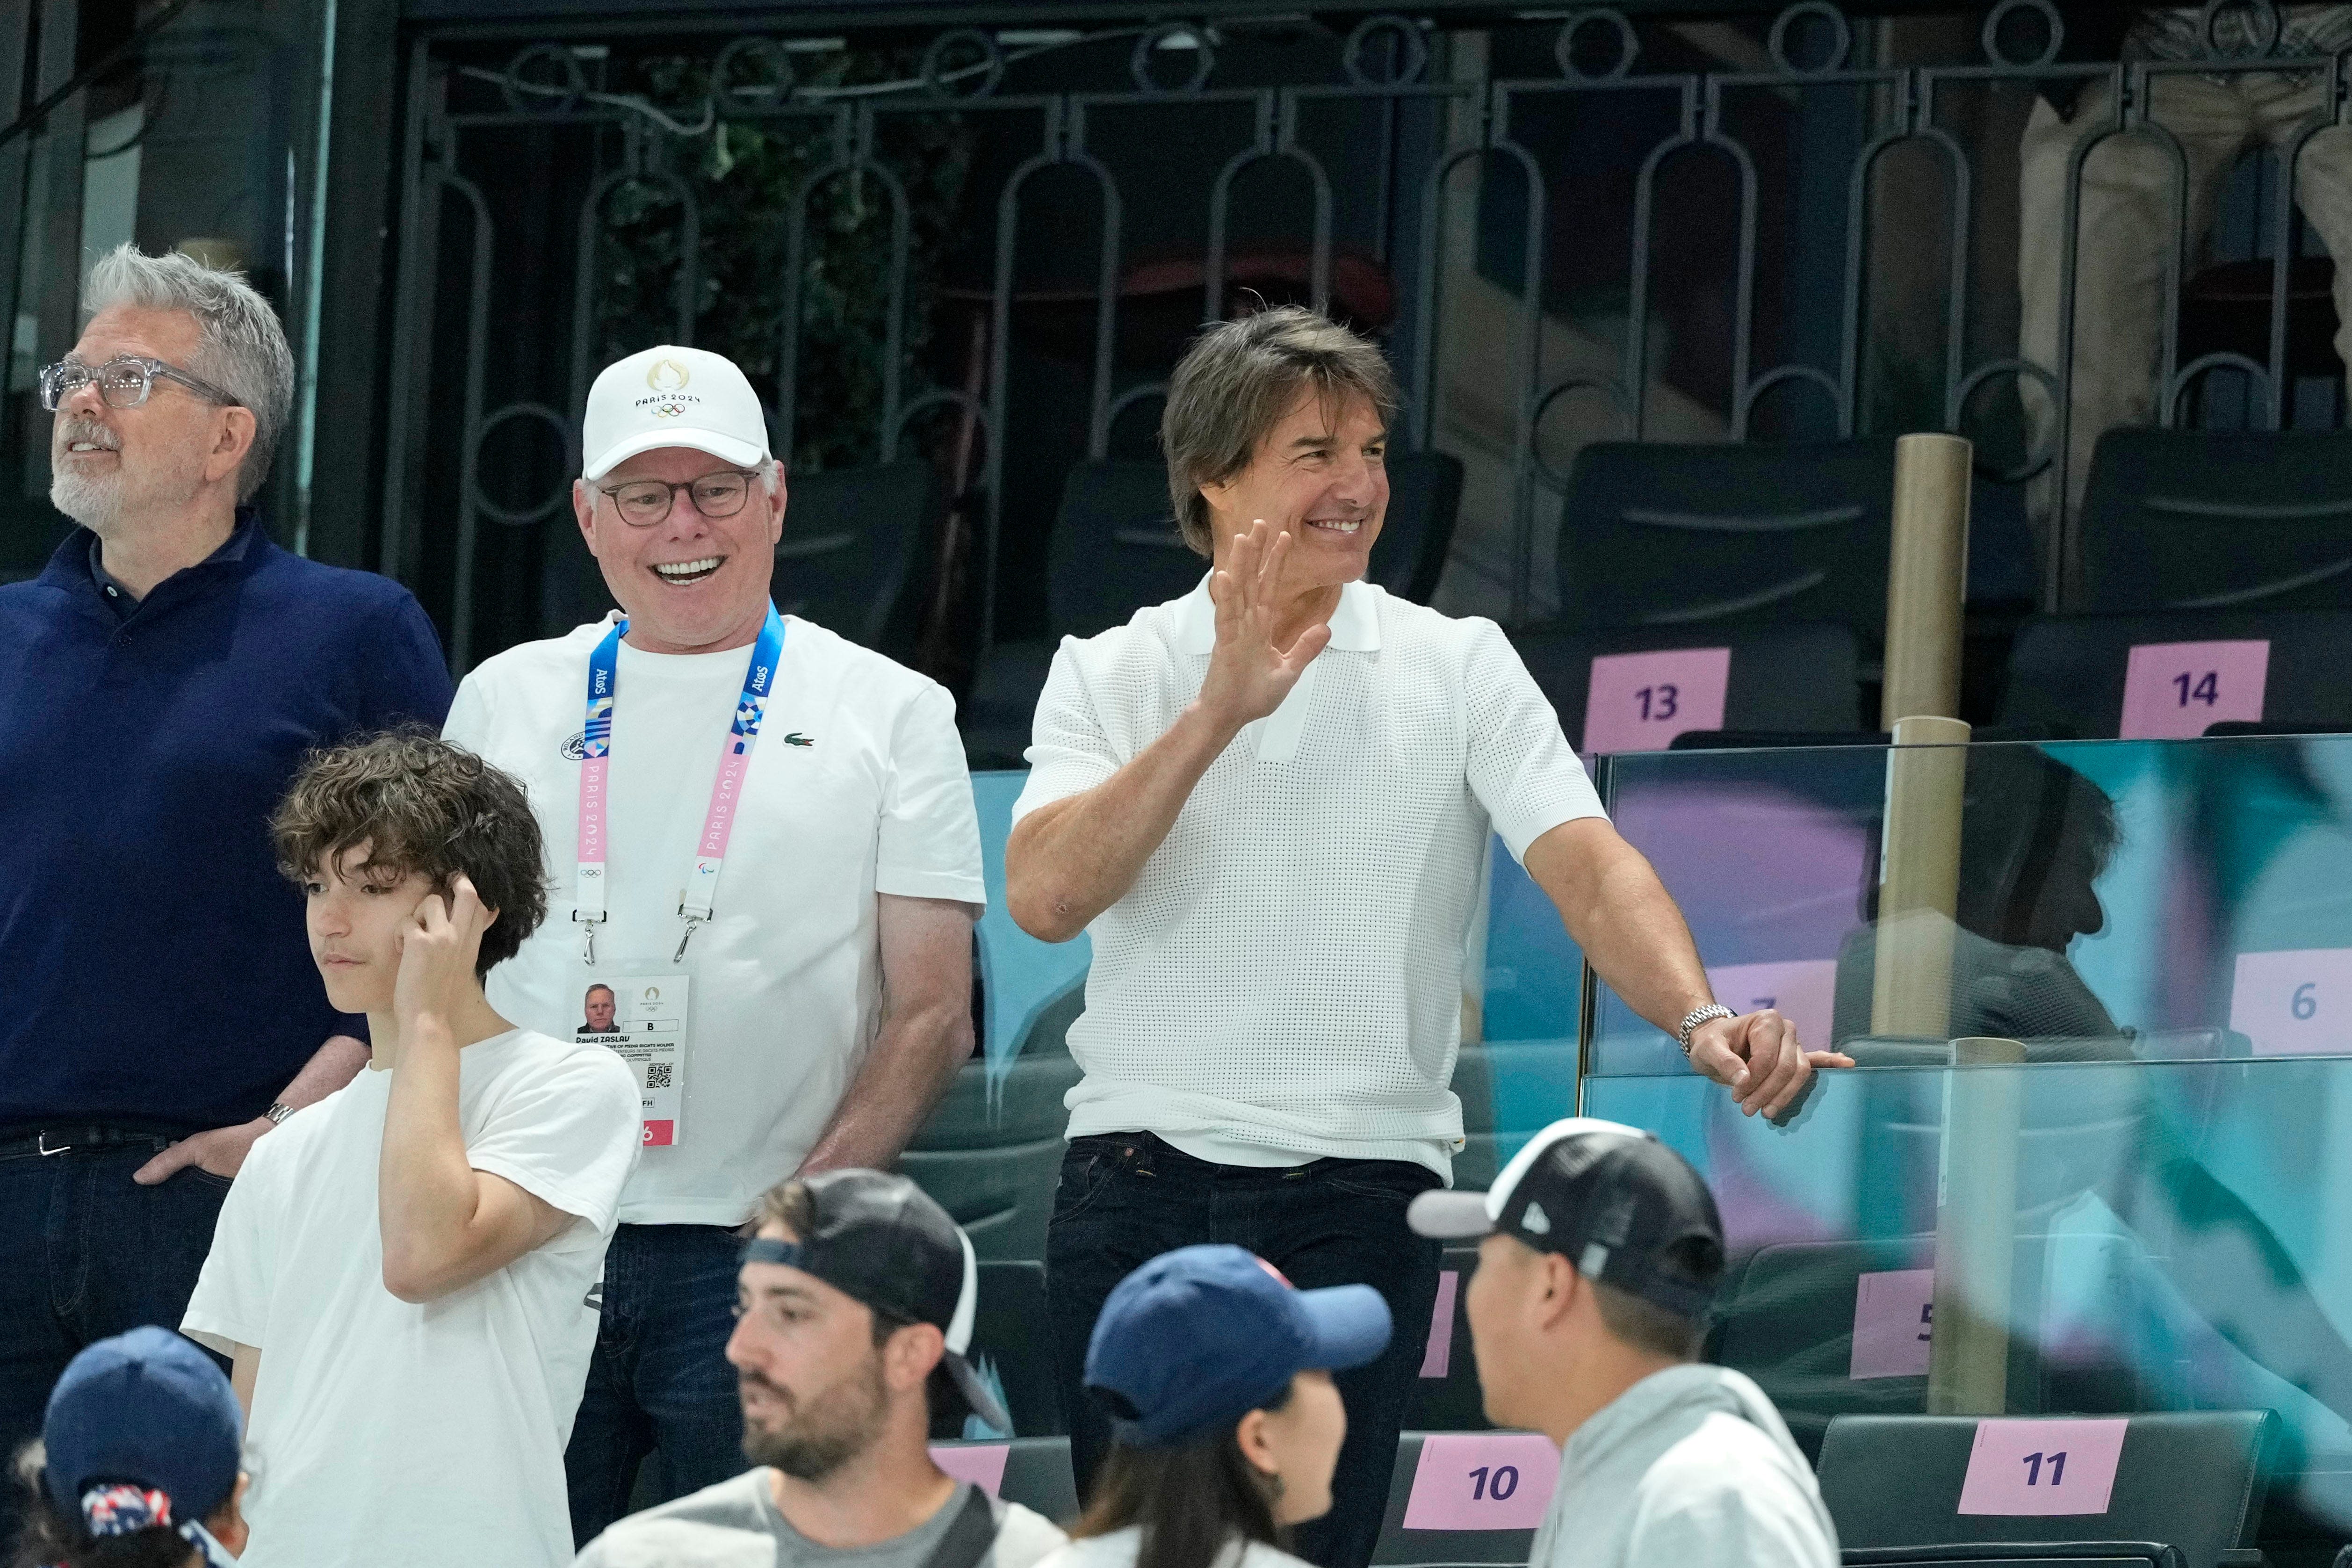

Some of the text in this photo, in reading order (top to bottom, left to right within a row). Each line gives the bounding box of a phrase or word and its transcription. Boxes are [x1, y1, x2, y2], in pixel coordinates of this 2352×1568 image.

[636, 394, 700, 407] PARIS 2024
[595, 669, 608, 694] Atos
[751, 665, 768, 693] Atos
[2173, 671, 2219, 708] 14
[1636, 685, 1678, 721] 13
[563, 733, 584, 751] ROLAND
[585, 766, 599, 855] PARIS 2024
[706, 761, 739, 850] PARIS 2024
[2291, 983, 2316, 1020] 6
[643, 1126, 653, 1142] 6
[1469, 1466, 1519, 1501] 10
[2022, 1452, 2067, 1486] 11
